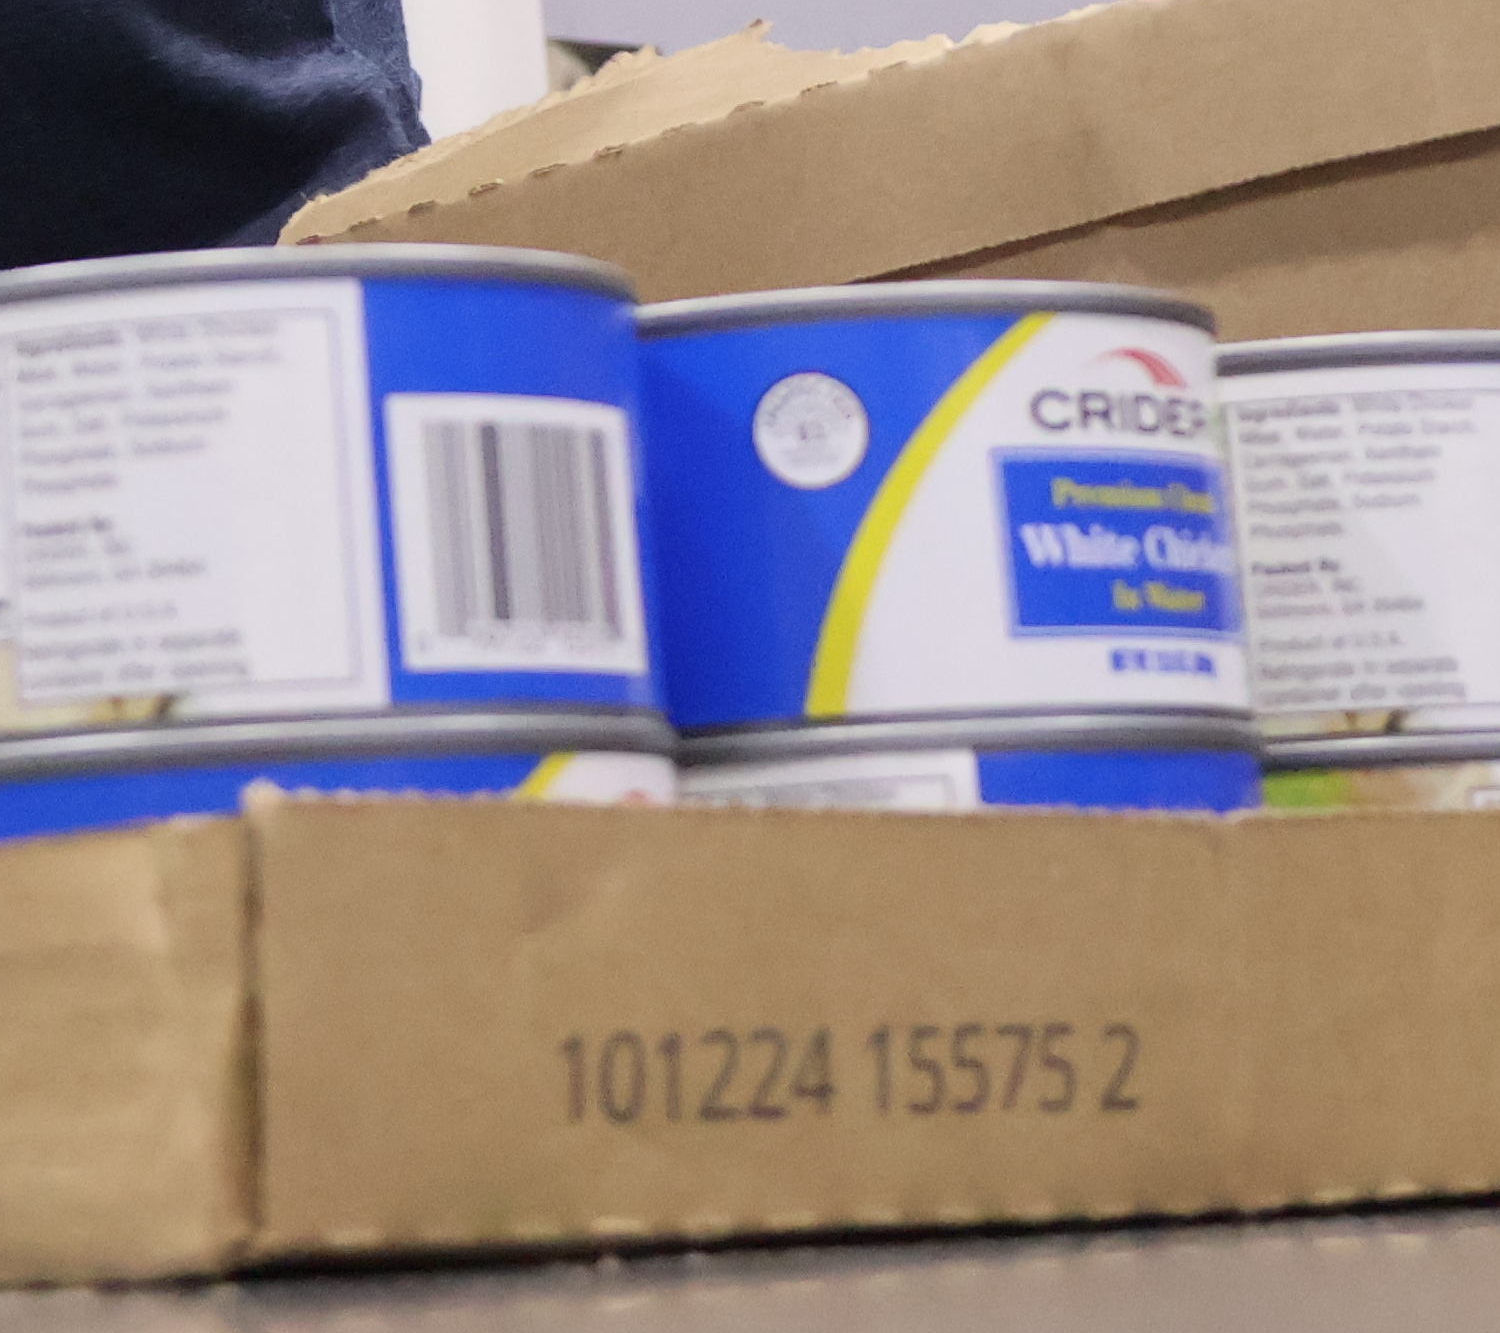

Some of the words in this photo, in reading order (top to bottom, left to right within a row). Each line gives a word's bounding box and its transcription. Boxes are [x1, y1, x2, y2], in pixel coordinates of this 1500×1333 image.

[557, 1026, 834, 1125] 101224
[866, 1022, 1076, 1115] 15575
[1099, 1021, 1141, 1113] 2
